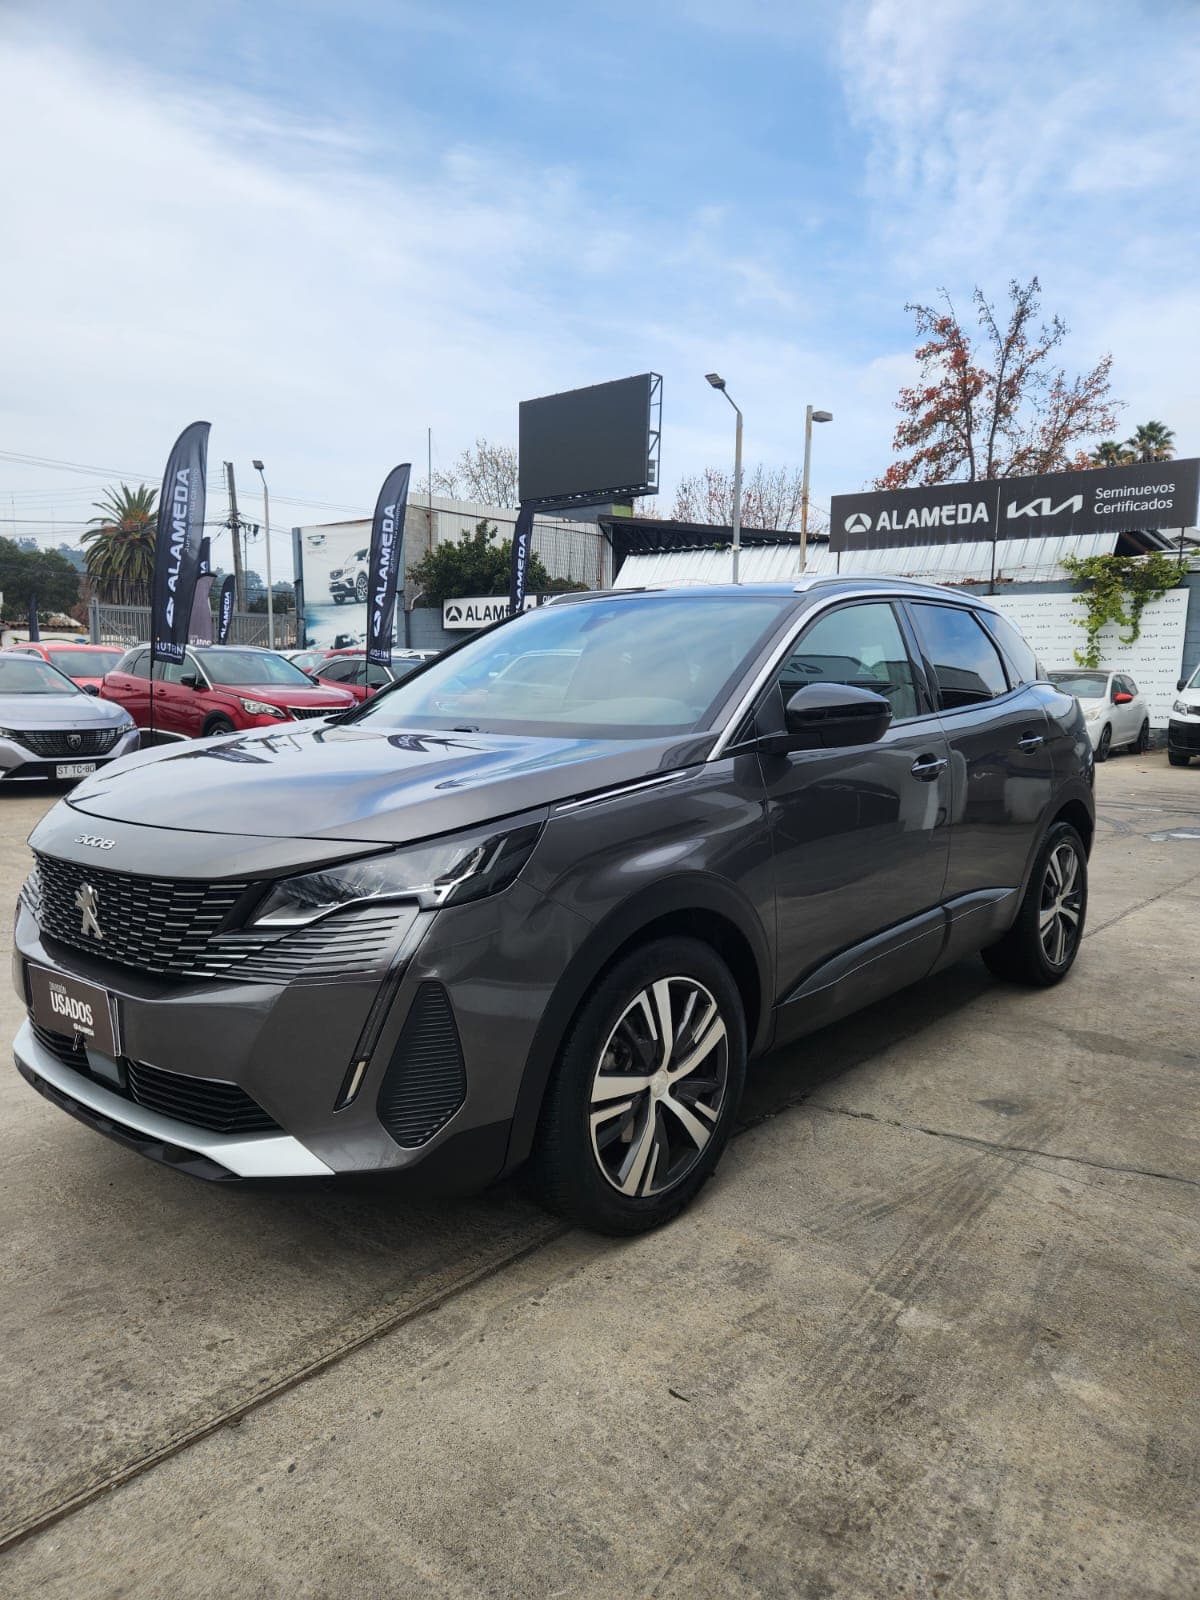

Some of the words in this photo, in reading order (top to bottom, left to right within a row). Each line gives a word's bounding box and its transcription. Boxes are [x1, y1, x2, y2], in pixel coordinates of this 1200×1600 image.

[1093, 497, 1173, 515] Certificados
[1095, 482, 1176, 499] Seminuevos
[167, 468, 190, 593] ALAMEDA
[875, 502, 989, 531] ALAMEDA
[1006, 495, 1083, 519] KIA
[374, 504, 396, 607] ALAMEDA
[515, 534, 526, 612] LAMEDA
[57, 766, 68, 775] ST
[74, 834, 116, 850] 3008
[50, 991, 93, 1026] USADOS
